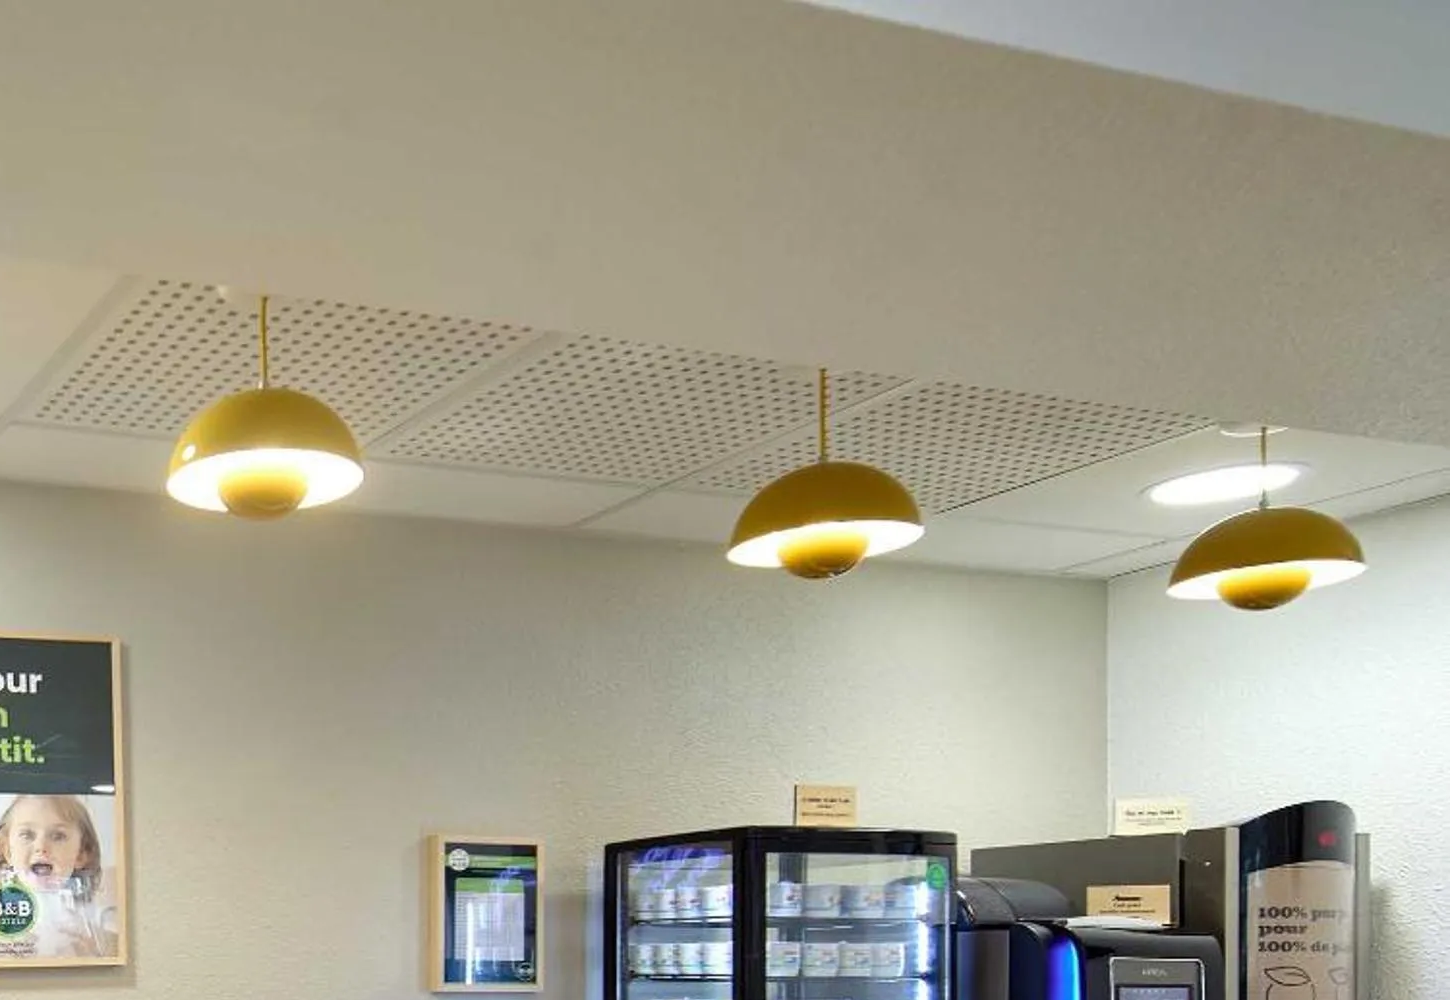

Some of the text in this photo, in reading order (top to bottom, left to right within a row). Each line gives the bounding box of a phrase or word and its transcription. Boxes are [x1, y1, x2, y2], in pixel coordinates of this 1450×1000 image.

[1258, 906, 1308, 919] 100%
[1258, 926, 1307, 938] pour
[1258, 941, 1307, 953] 100%
